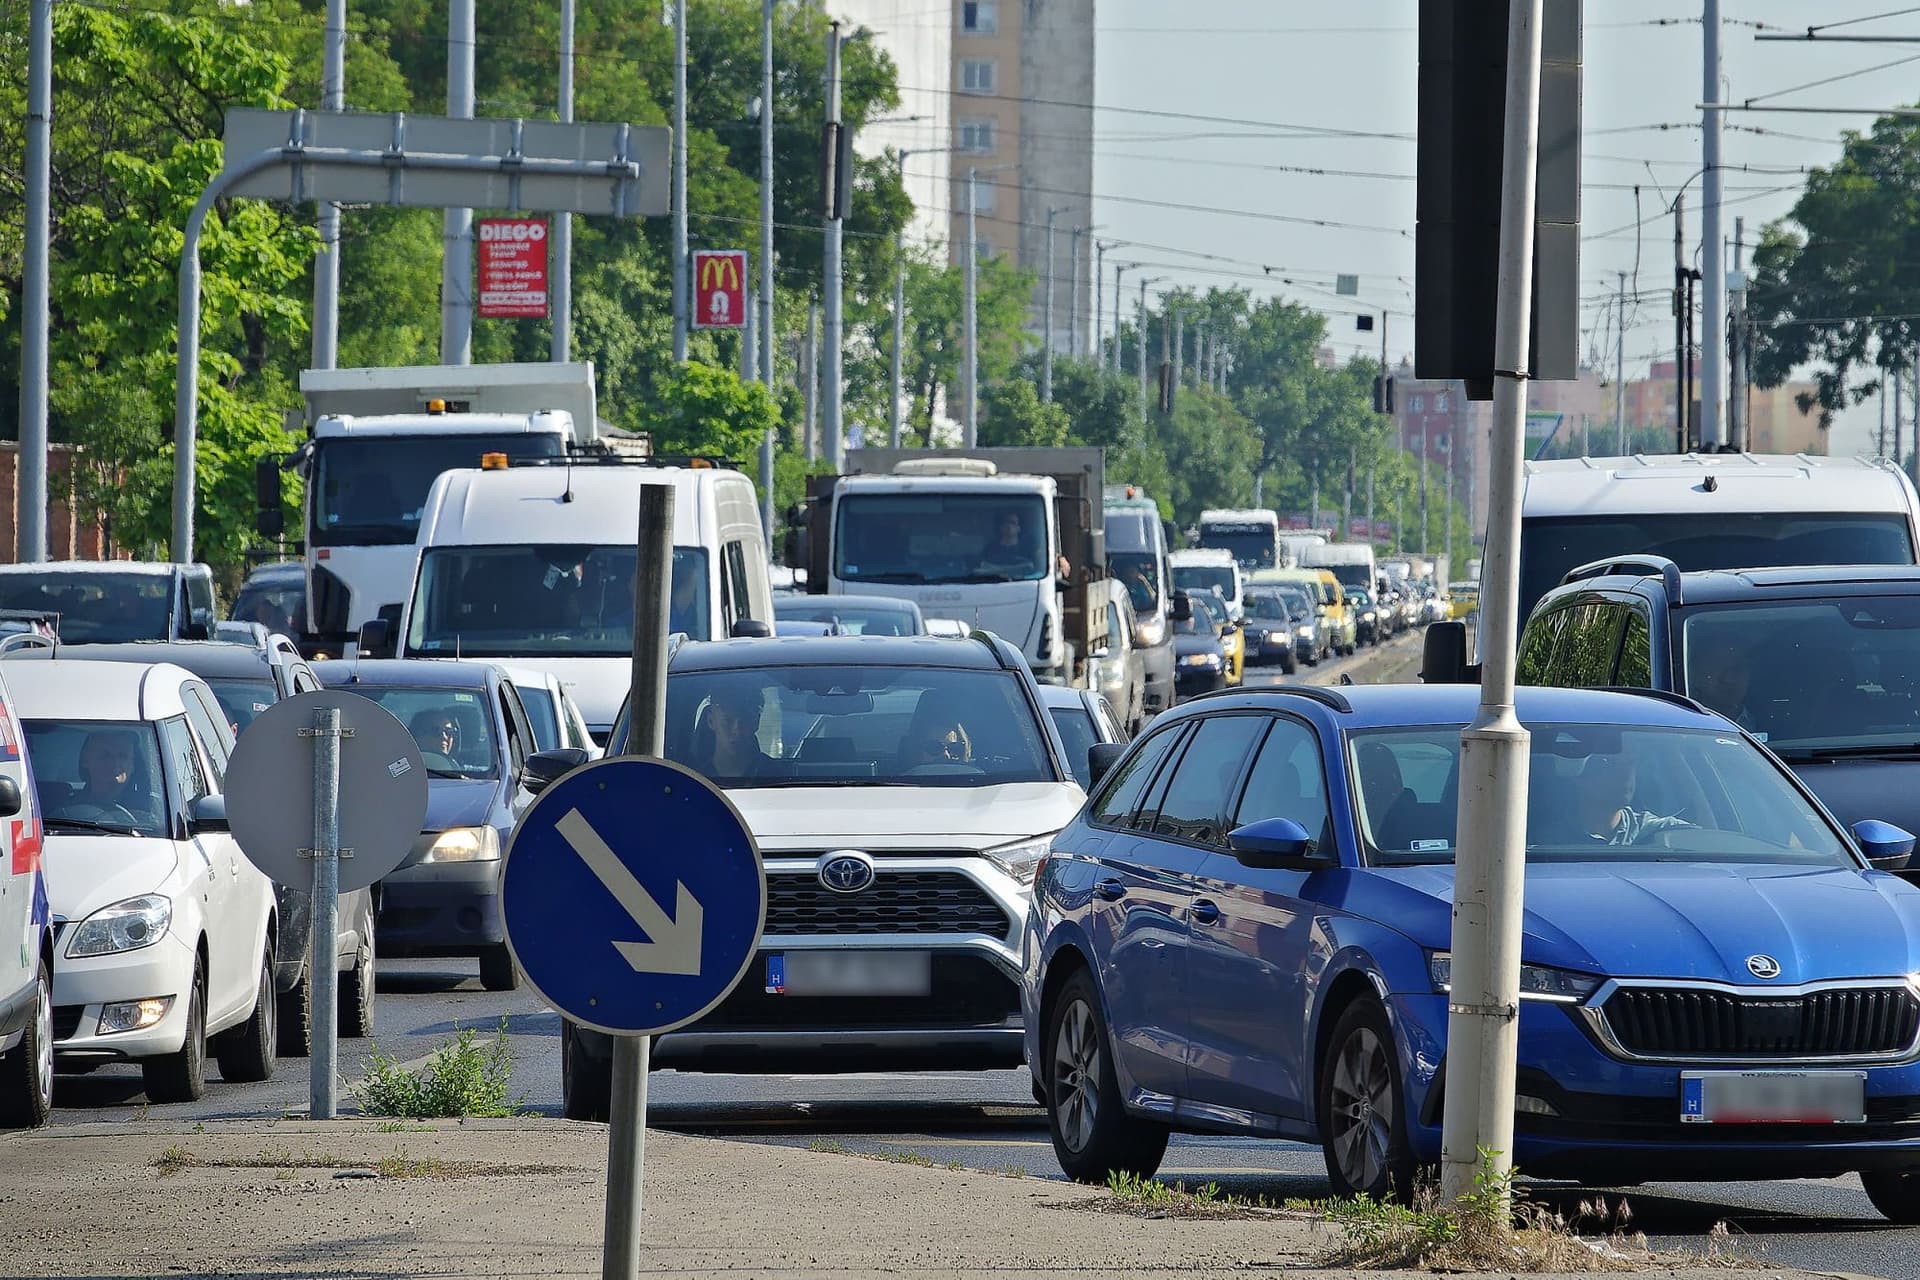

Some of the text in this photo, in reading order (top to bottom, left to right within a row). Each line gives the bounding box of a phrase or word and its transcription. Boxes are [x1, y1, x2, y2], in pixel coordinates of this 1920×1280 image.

[480, 224, 546, 241] DIEGO
[772, 974, 780, 984] H
[1688, 1099, 1697, 1111] H
